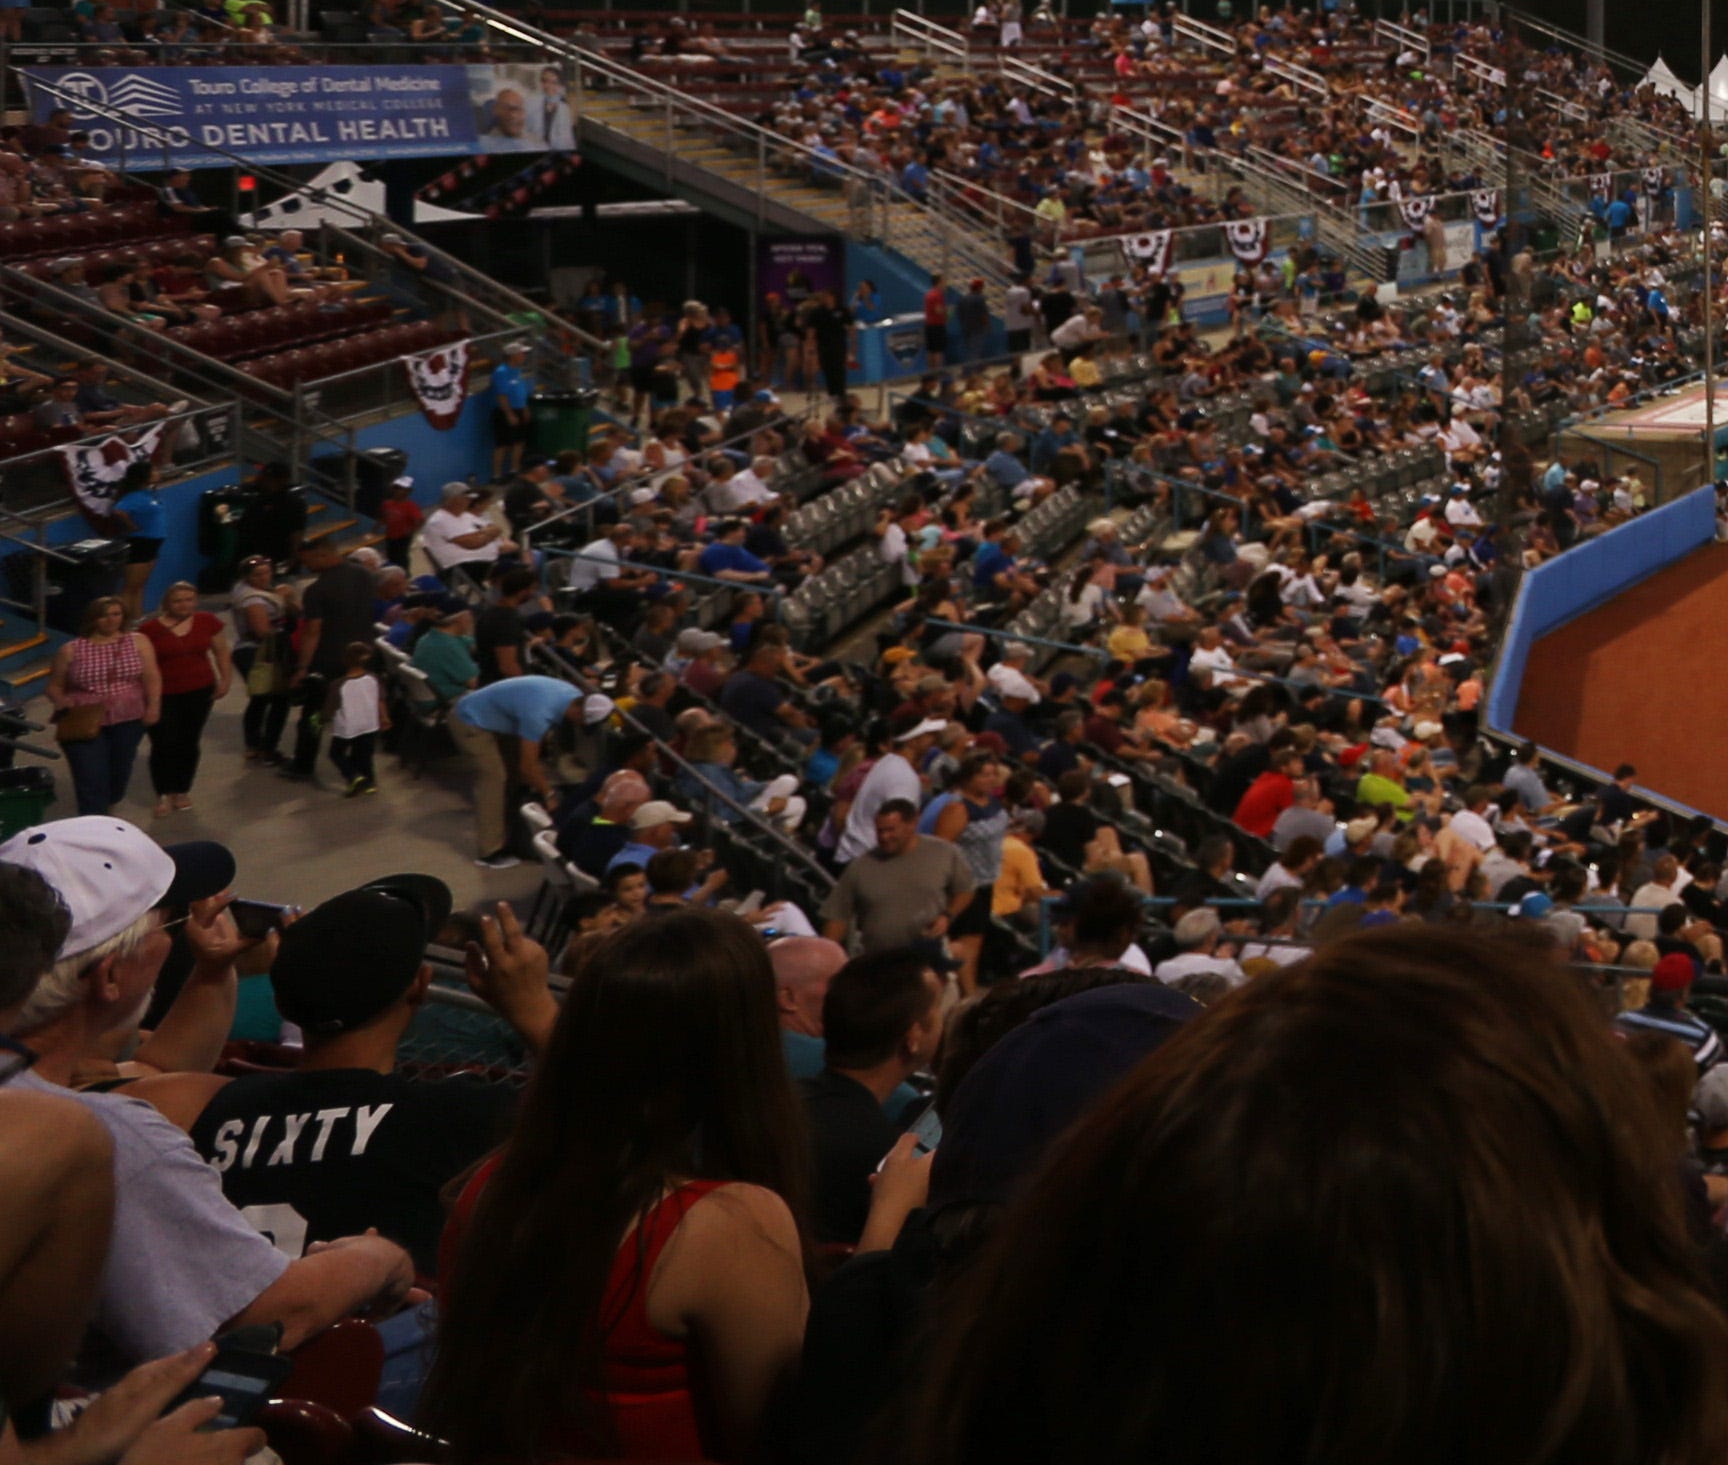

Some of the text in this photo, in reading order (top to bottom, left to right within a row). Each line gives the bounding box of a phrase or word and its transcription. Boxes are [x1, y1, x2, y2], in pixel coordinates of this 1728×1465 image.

[189, 76, 441, 99] Touro College of Dental Medicine
[195, 98, 444, 115] AT NEW YORK MEDICAL COLLEGE
[203, 122, 331, 147] DENTAL
[338, 117, 450, 141] HEALTH
[209, 1103, 394, 1173] SIXTY
